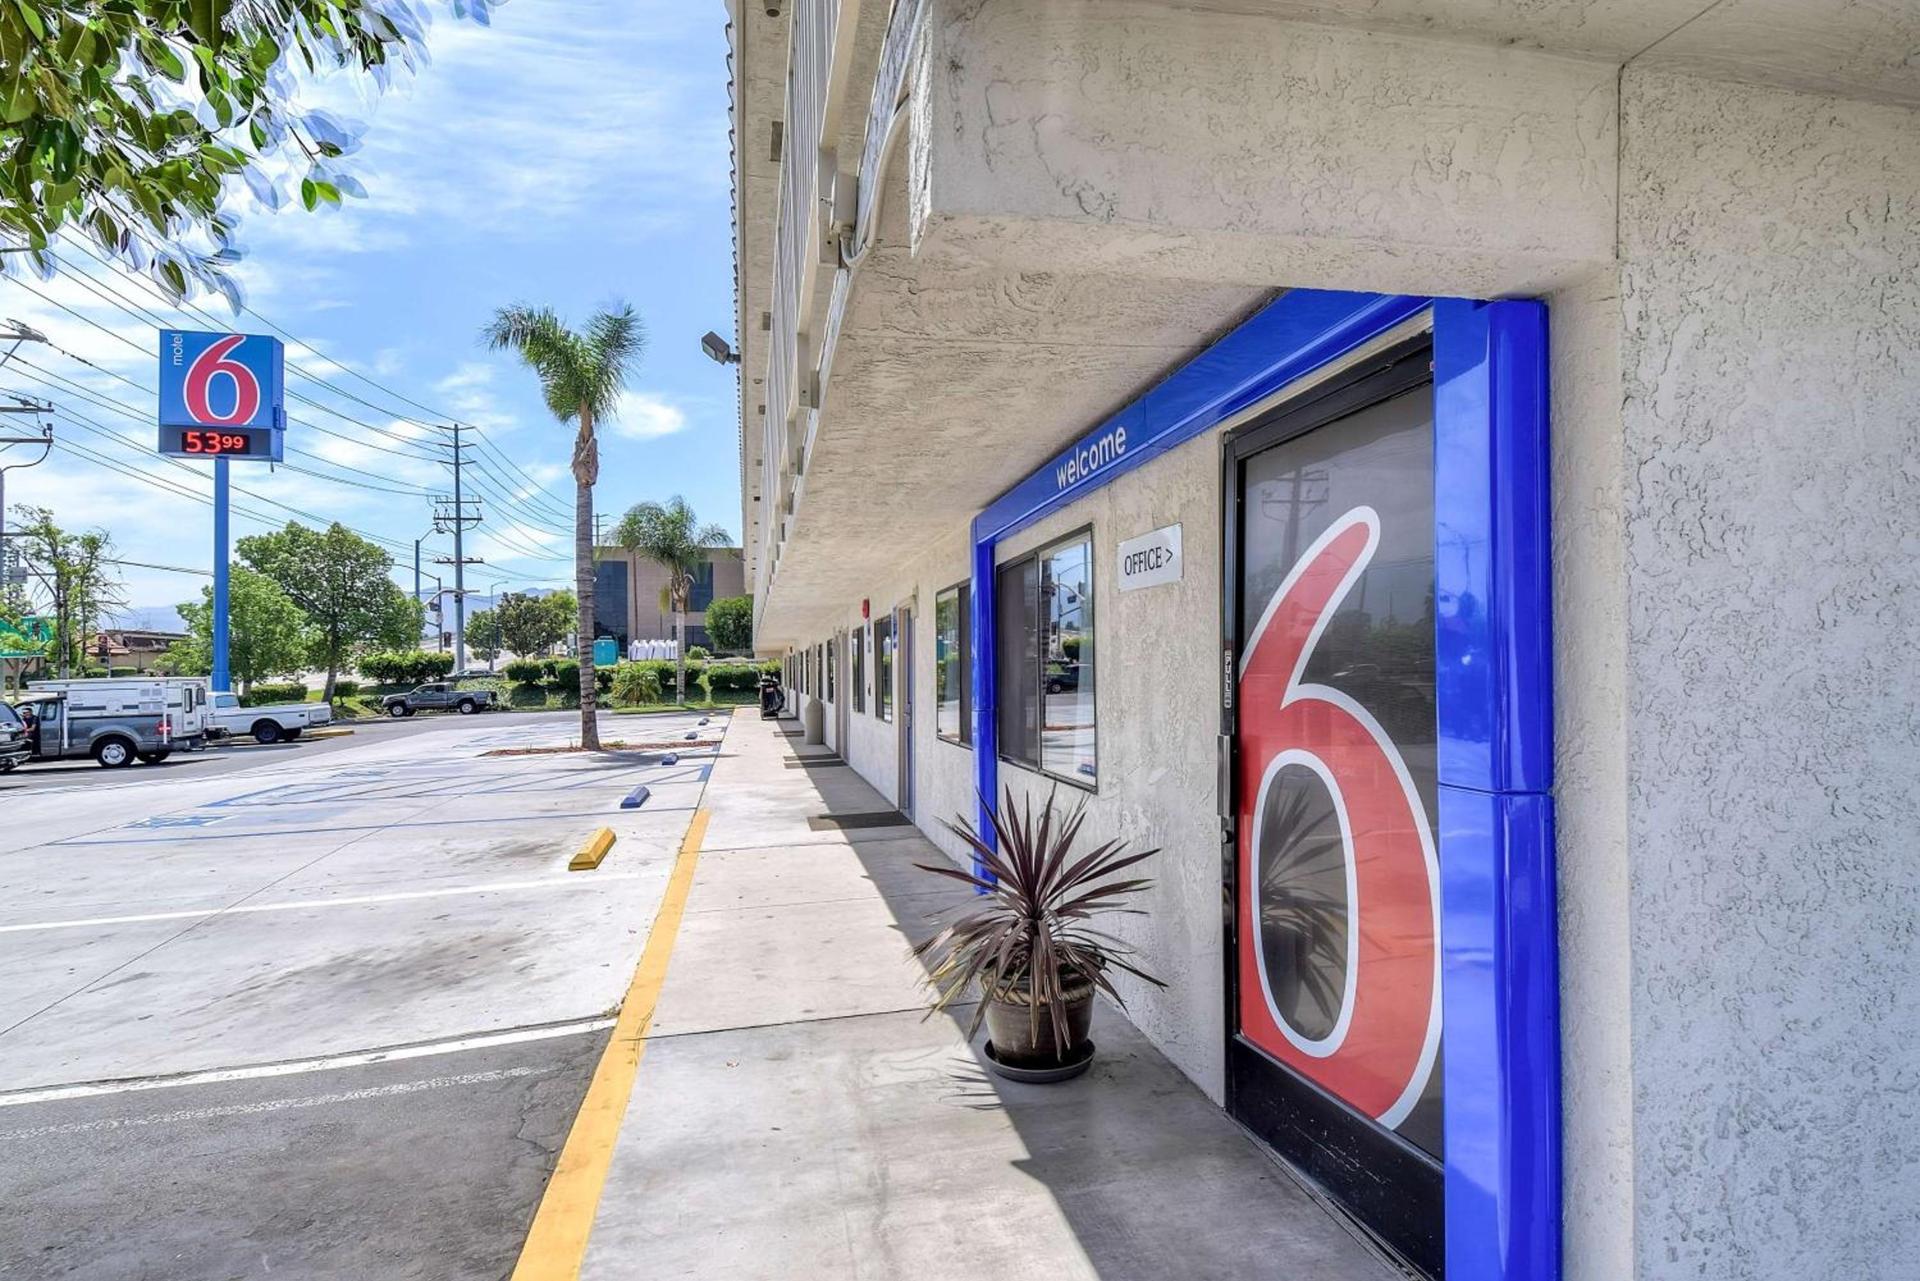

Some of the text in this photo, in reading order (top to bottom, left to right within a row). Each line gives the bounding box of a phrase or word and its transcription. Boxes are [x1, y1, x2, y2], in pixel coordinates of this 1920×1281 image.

[171, 333, 183, 366] motel
[183, 335, 261, 425] 6
[1056, 426, 1127, 490] welcome
[1124, 546, 1162, 576] OFFICE
[1239, 505, 1443, 1131] 6
